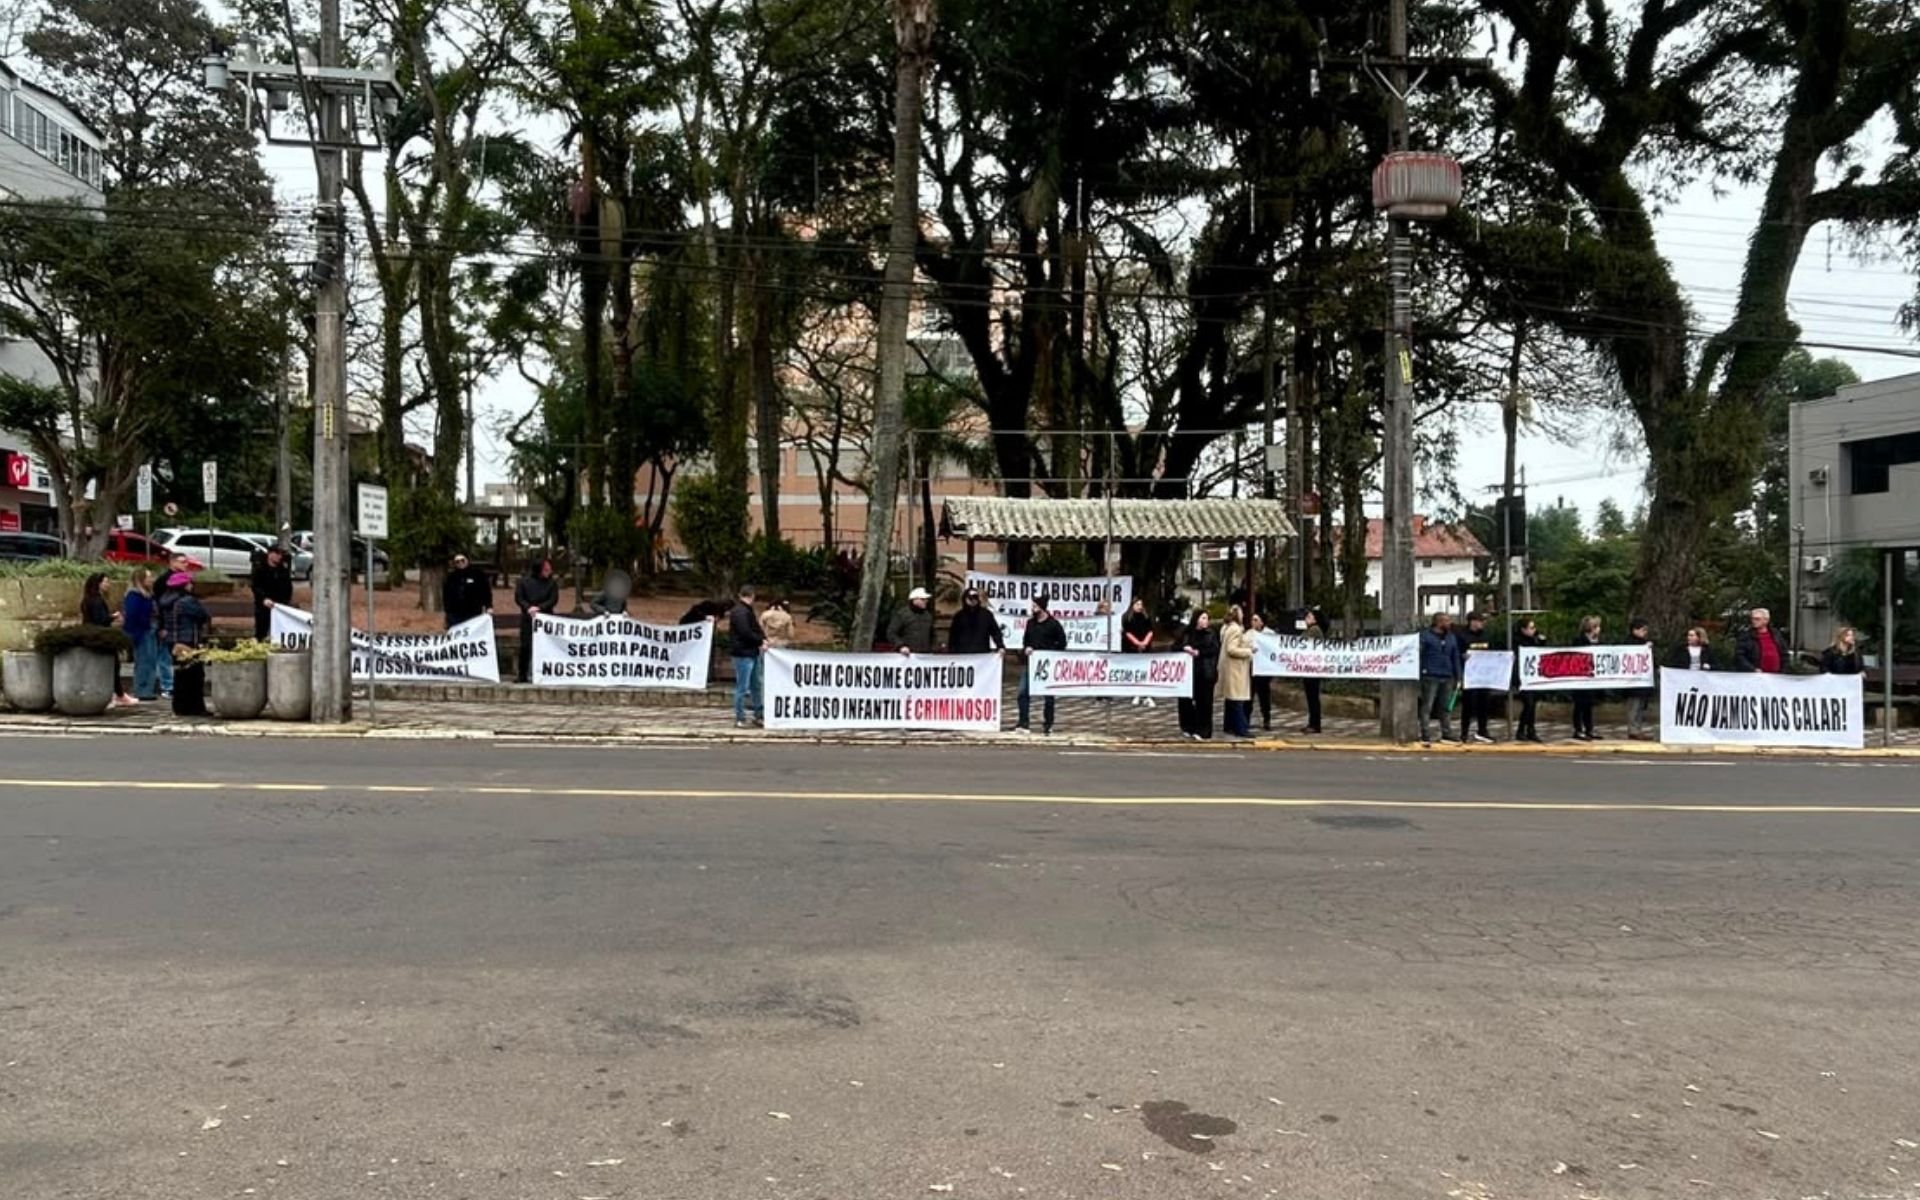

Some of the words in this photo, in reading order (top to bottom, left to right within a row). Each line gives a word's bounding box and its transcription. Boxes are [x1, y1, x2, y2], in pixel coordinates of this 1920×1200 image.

[1020, 581, 1037, 600] DE
[533, 618, 565, 637] POR
[569, 621, 602, 638] UMA
[606, 620, 661, 641] CIDADE
[663, 626, 703, 644] MAIS
[280, 631, 313, 650] LON
[414, 641, 488, 663] CRIANÇAS
[567, 642, 628, 658] SEGURA
[630, 642, 670, 661] PARA
[542, 662, 607, 678] NOSSAS
[611, 662, 691, 681] CRIANÇAS!
[793, 663, 832, 686] QUEM
[835, 664, 901, 689] CONSOME
[904, 661, 975, 689] CONTEÚDO
[1034, 658, 1050, 682] AS
[774, 696, 791, 718] DE
[793, 697, 839, 719] ABUSO
[843, 697, 902, 720] INFANTIL
[904, 694, 912, 720] É
[915, 698, 997, 721] CRIMINOSO!
[1675, 686, 1708, 727] NÃO
[1710, 694, 1758, 730] VAMOS
[1761, 696, 1789, 731] NOS
[1792, 696, 1847, 732] CALAR!
